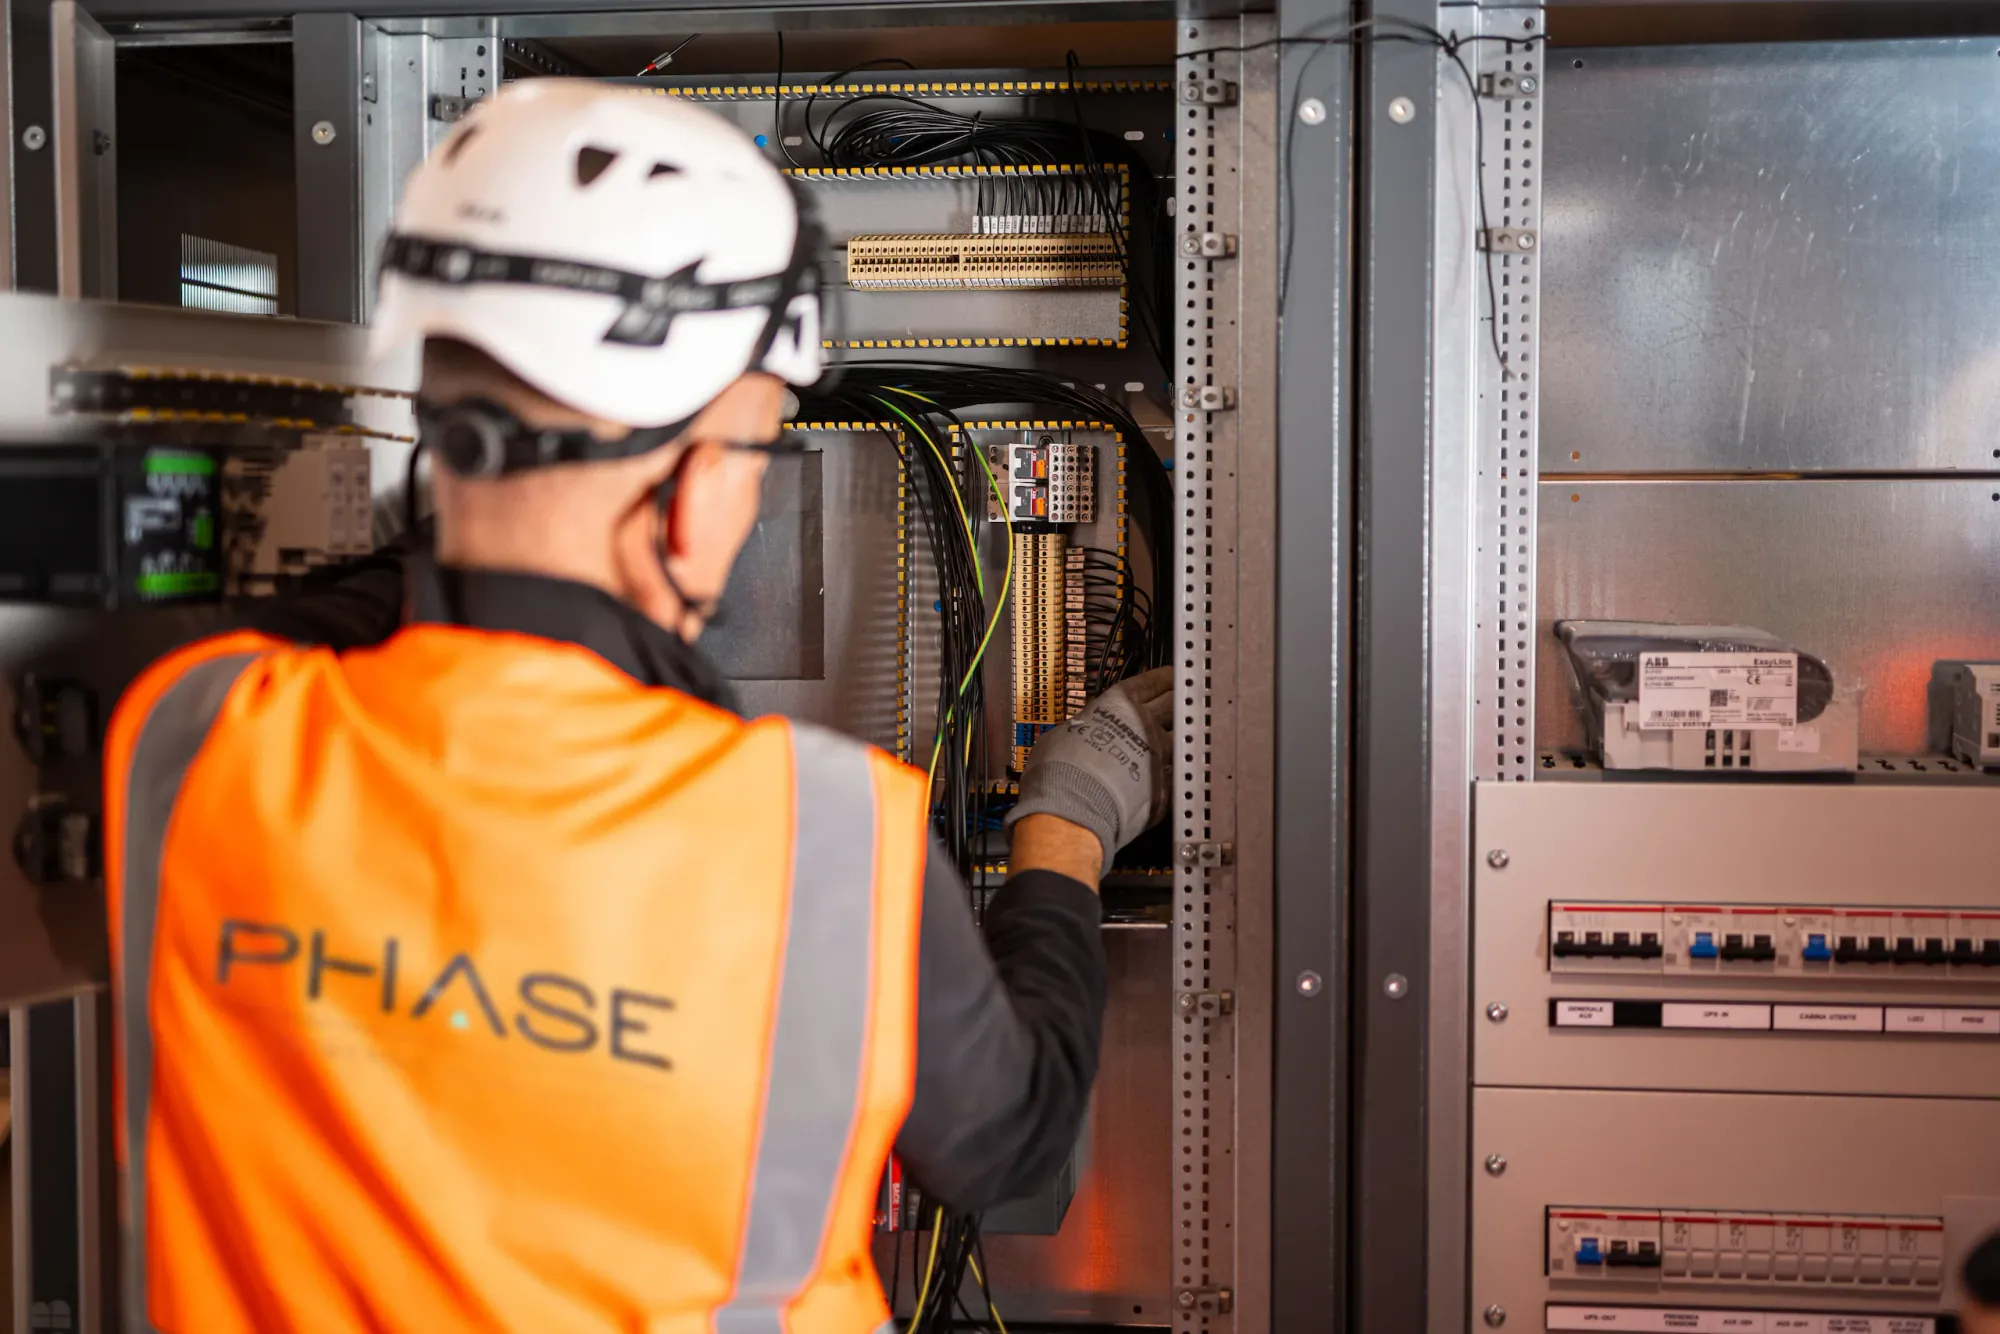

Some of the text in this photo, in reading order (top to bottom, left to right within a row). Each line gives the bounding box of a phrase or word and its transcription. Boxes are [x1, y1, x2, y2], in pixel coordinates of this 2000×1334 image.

[1645, 657, 1670, 667] ABB
[1753, 658, 1792, 668] EasyLine
[215, 918, 677, 1071] PHASE
